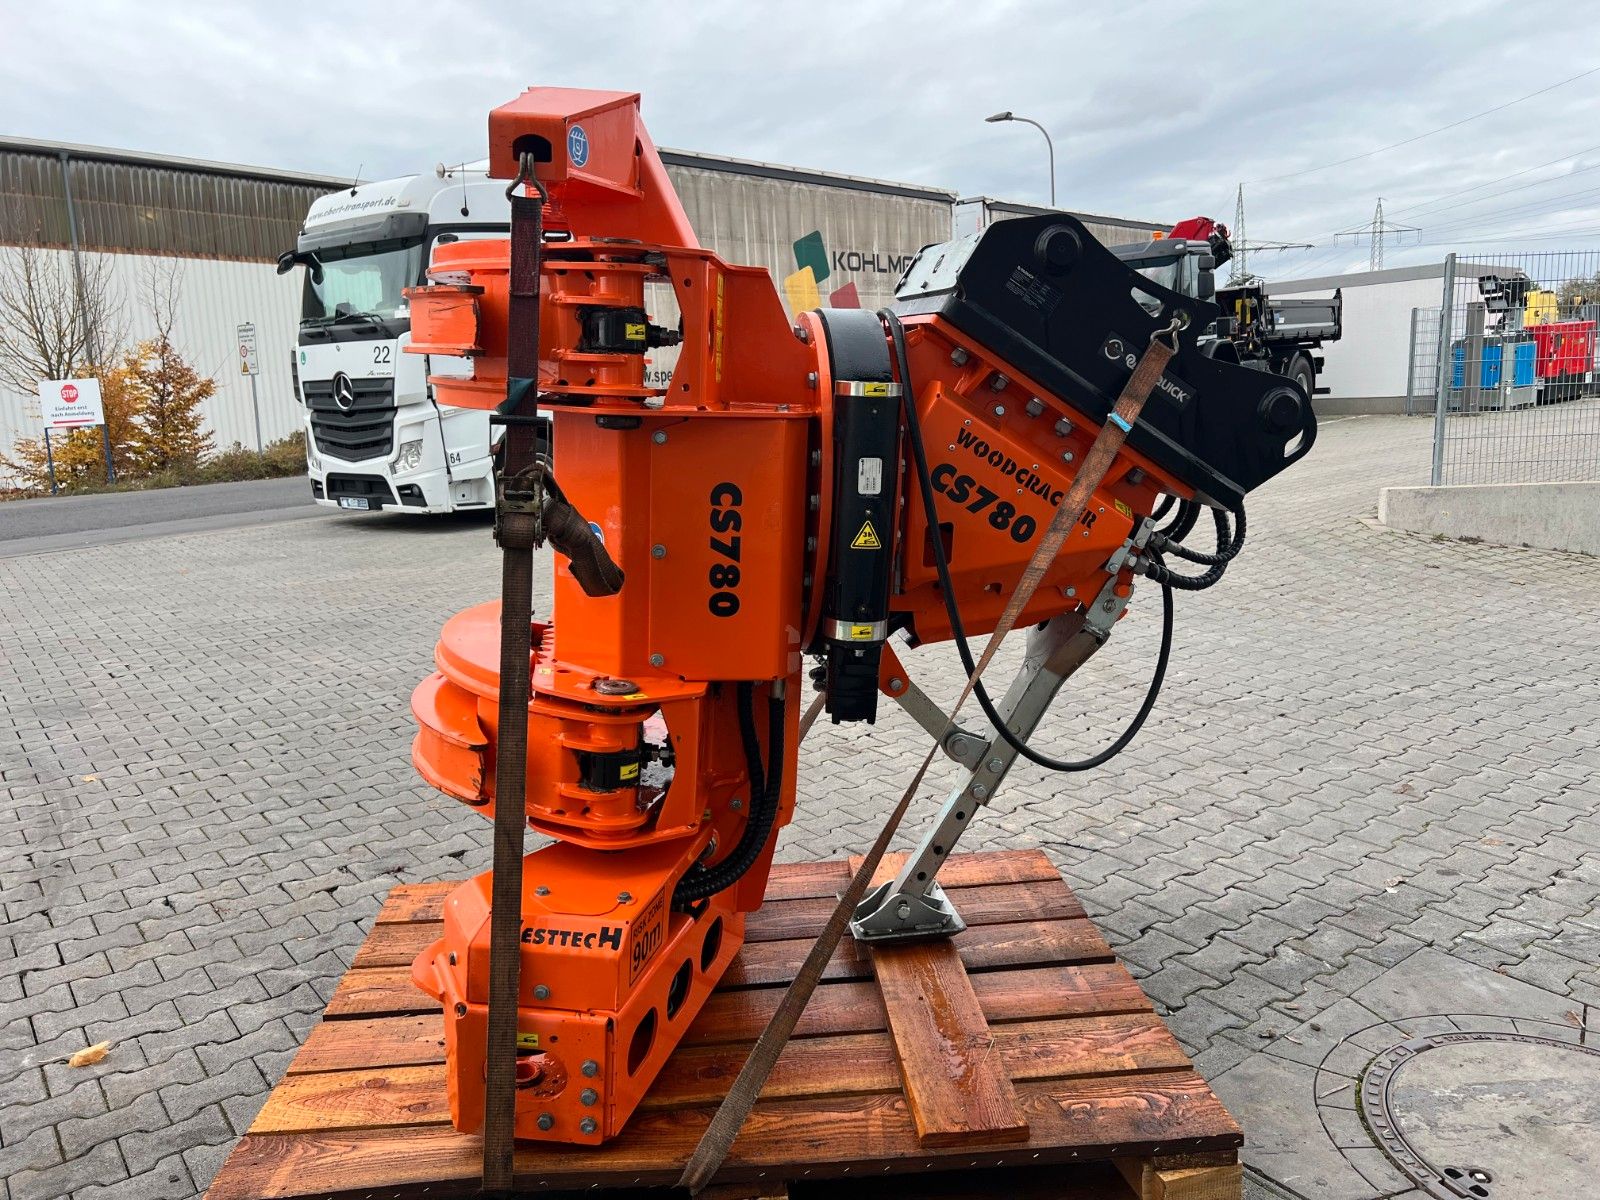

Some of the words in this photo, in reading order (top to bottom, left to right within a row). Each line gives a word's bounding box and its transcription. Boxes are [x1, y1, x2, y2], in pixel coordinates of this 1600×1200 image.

[374, 346, 390, 364] 22
[61, 389, 77, 399] STOP
[449, 452, 461, 464] 64
[957, 427, 1097, 529] WOODCRACR
[930, 463, 1037, 544] CS780
[708, 482, 742, 617] CS780
[520, 920, 623, 951] ESTTECH
[633, 918, 647, 938] RISK
[647, 896, 664, 923] ZONE
[632, 921, 661, 972] 90m
